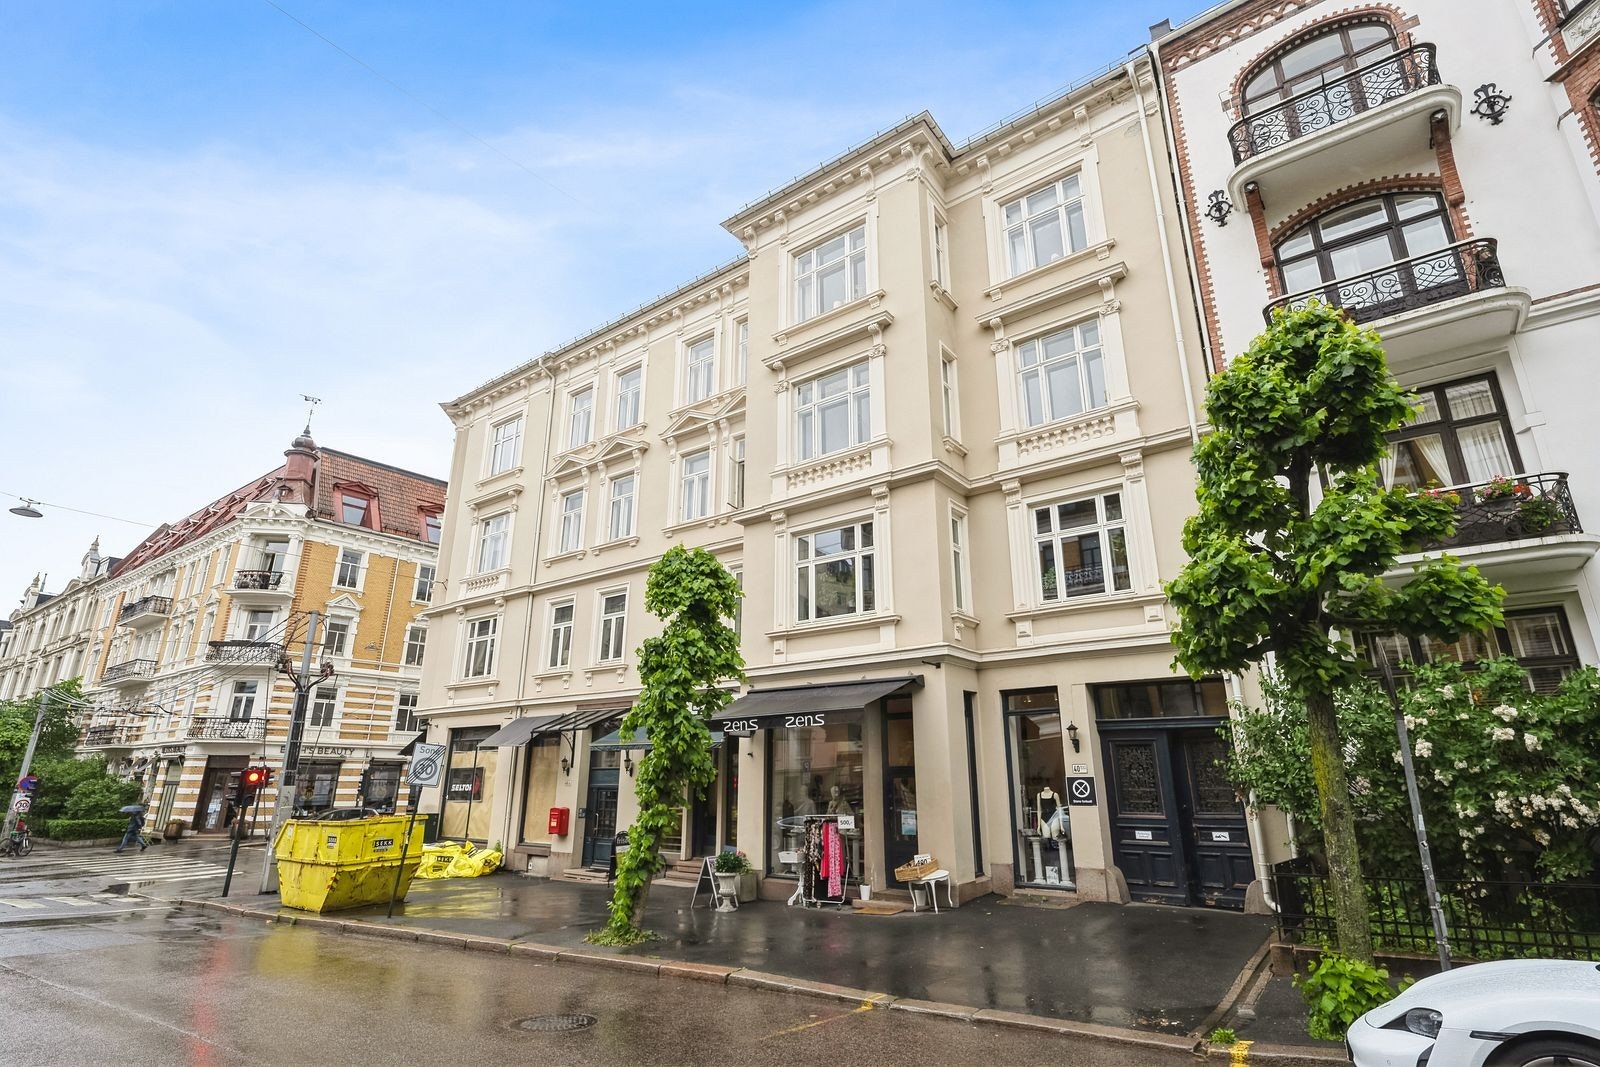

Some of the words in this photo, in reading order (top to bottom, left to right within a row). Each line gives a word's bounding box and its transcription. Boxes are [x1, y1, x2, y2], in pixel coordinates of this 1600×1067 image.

[723, 719, 758, 732] zens
[785, 713, 825, 728] zens
[280, 745, 315, 754] EH'S
[317, 747, 355, 756] BEAUTY
[419, 745, 438, 754] Son
